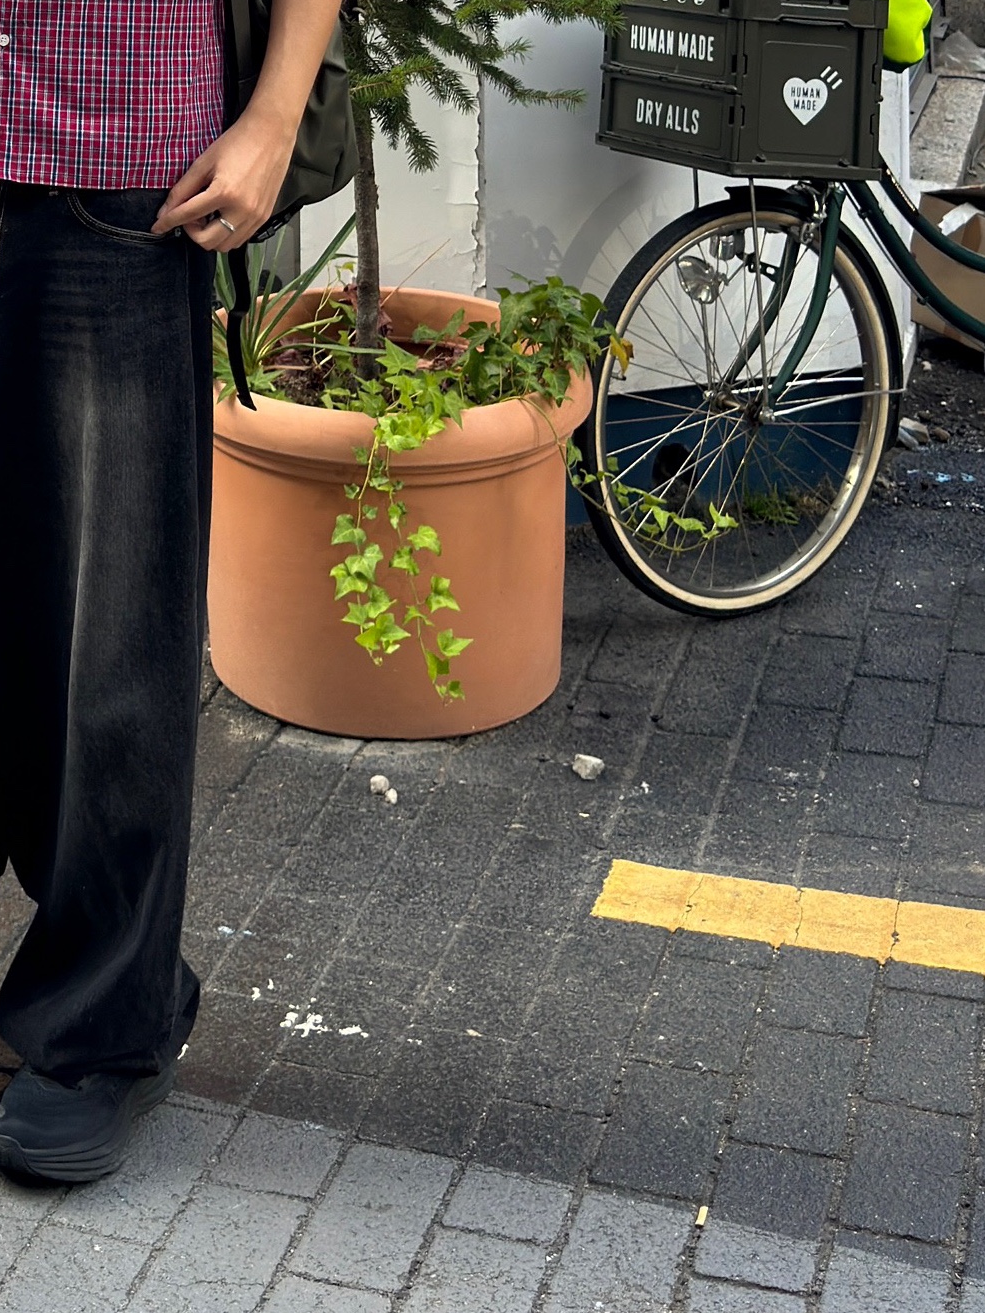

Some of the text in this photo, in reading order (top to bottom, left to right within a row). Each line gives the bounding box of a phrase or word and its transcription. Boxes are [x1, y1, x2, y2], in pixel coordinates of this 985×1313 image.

[630, 24, 715, 63] HUMAN MADE
[790, 86, 822, 100] HUMAN
[793, 98, 817, 112] MADE
[635, 97, 700, 135] DRY ALLS
